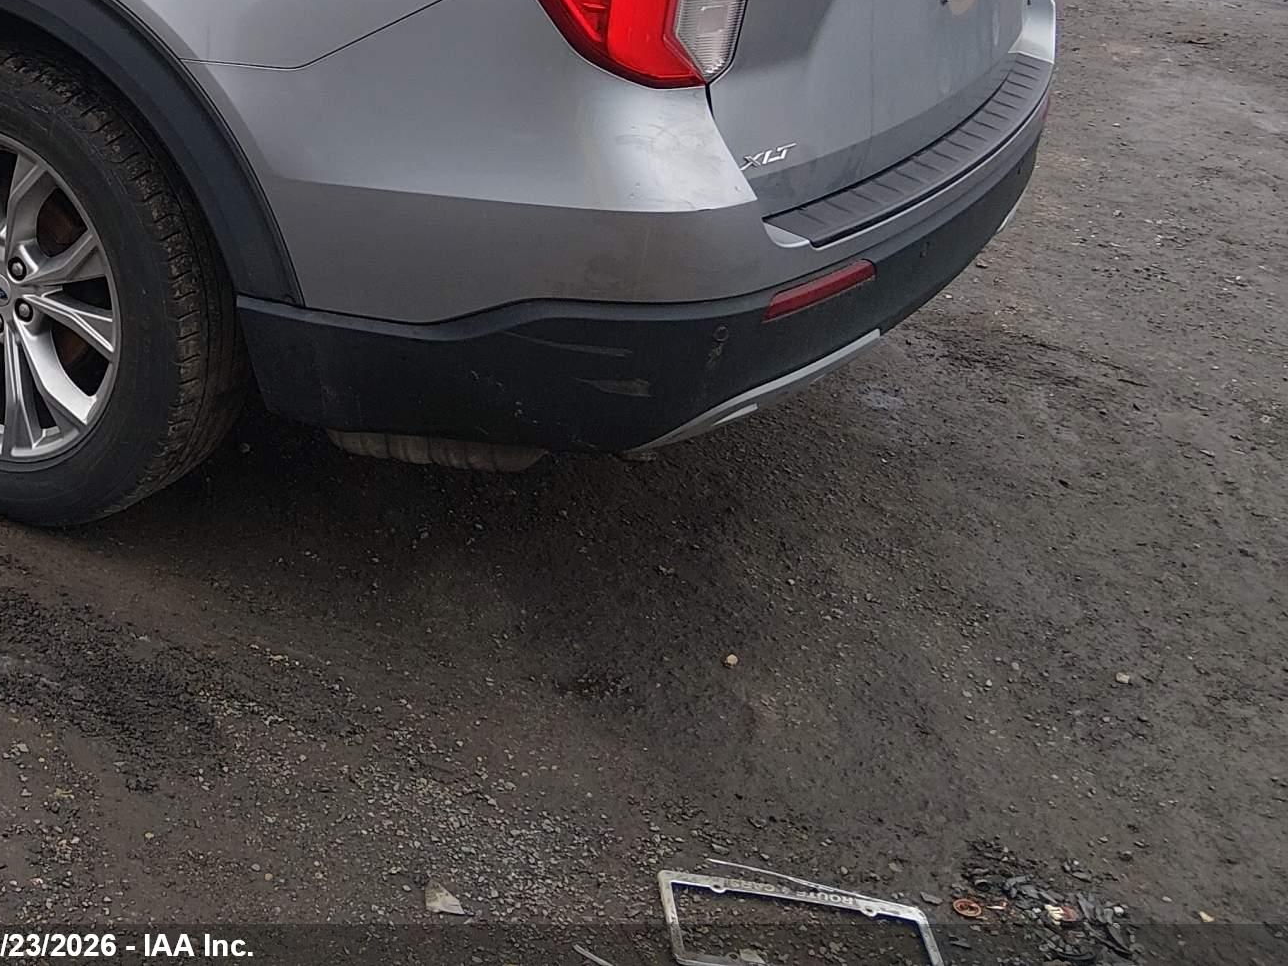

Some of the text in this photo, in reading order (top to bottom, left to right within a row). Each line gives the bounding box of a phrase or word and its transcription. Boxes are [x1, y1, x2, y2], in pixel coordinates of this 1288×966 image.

[739, 142, 797, 171] XLT
[728, 878, 775, 892] CARS
[796, 891, 854, 905] ROUTE
